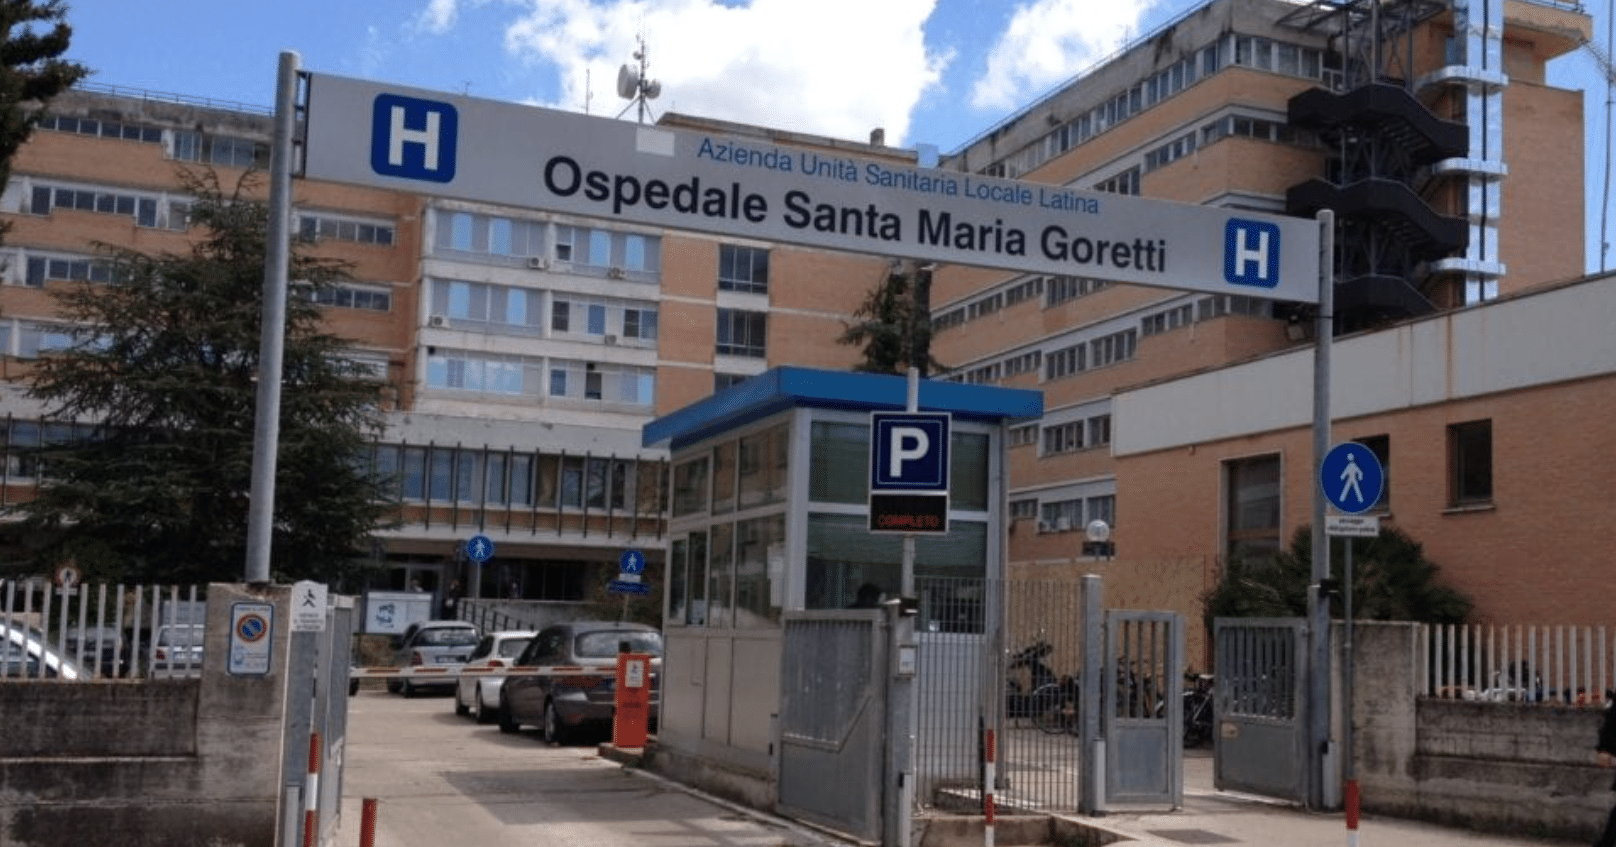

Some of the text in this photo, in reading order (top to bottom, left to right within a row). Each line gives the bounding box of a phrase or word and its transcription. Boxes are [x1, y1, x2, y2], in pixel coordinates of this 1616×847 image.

[388, 105, 441, 171] H
[697, 137, 1099, 214] Azienda Unità Sanitaria Locale Latina
[544, 155, 1166, 272] Ospedale Santa Maria Goretti
[1235, 228, 1269, 279] H
[889, 426, 930, 478] P
[878, 515, 940, 528] COMPLETO
